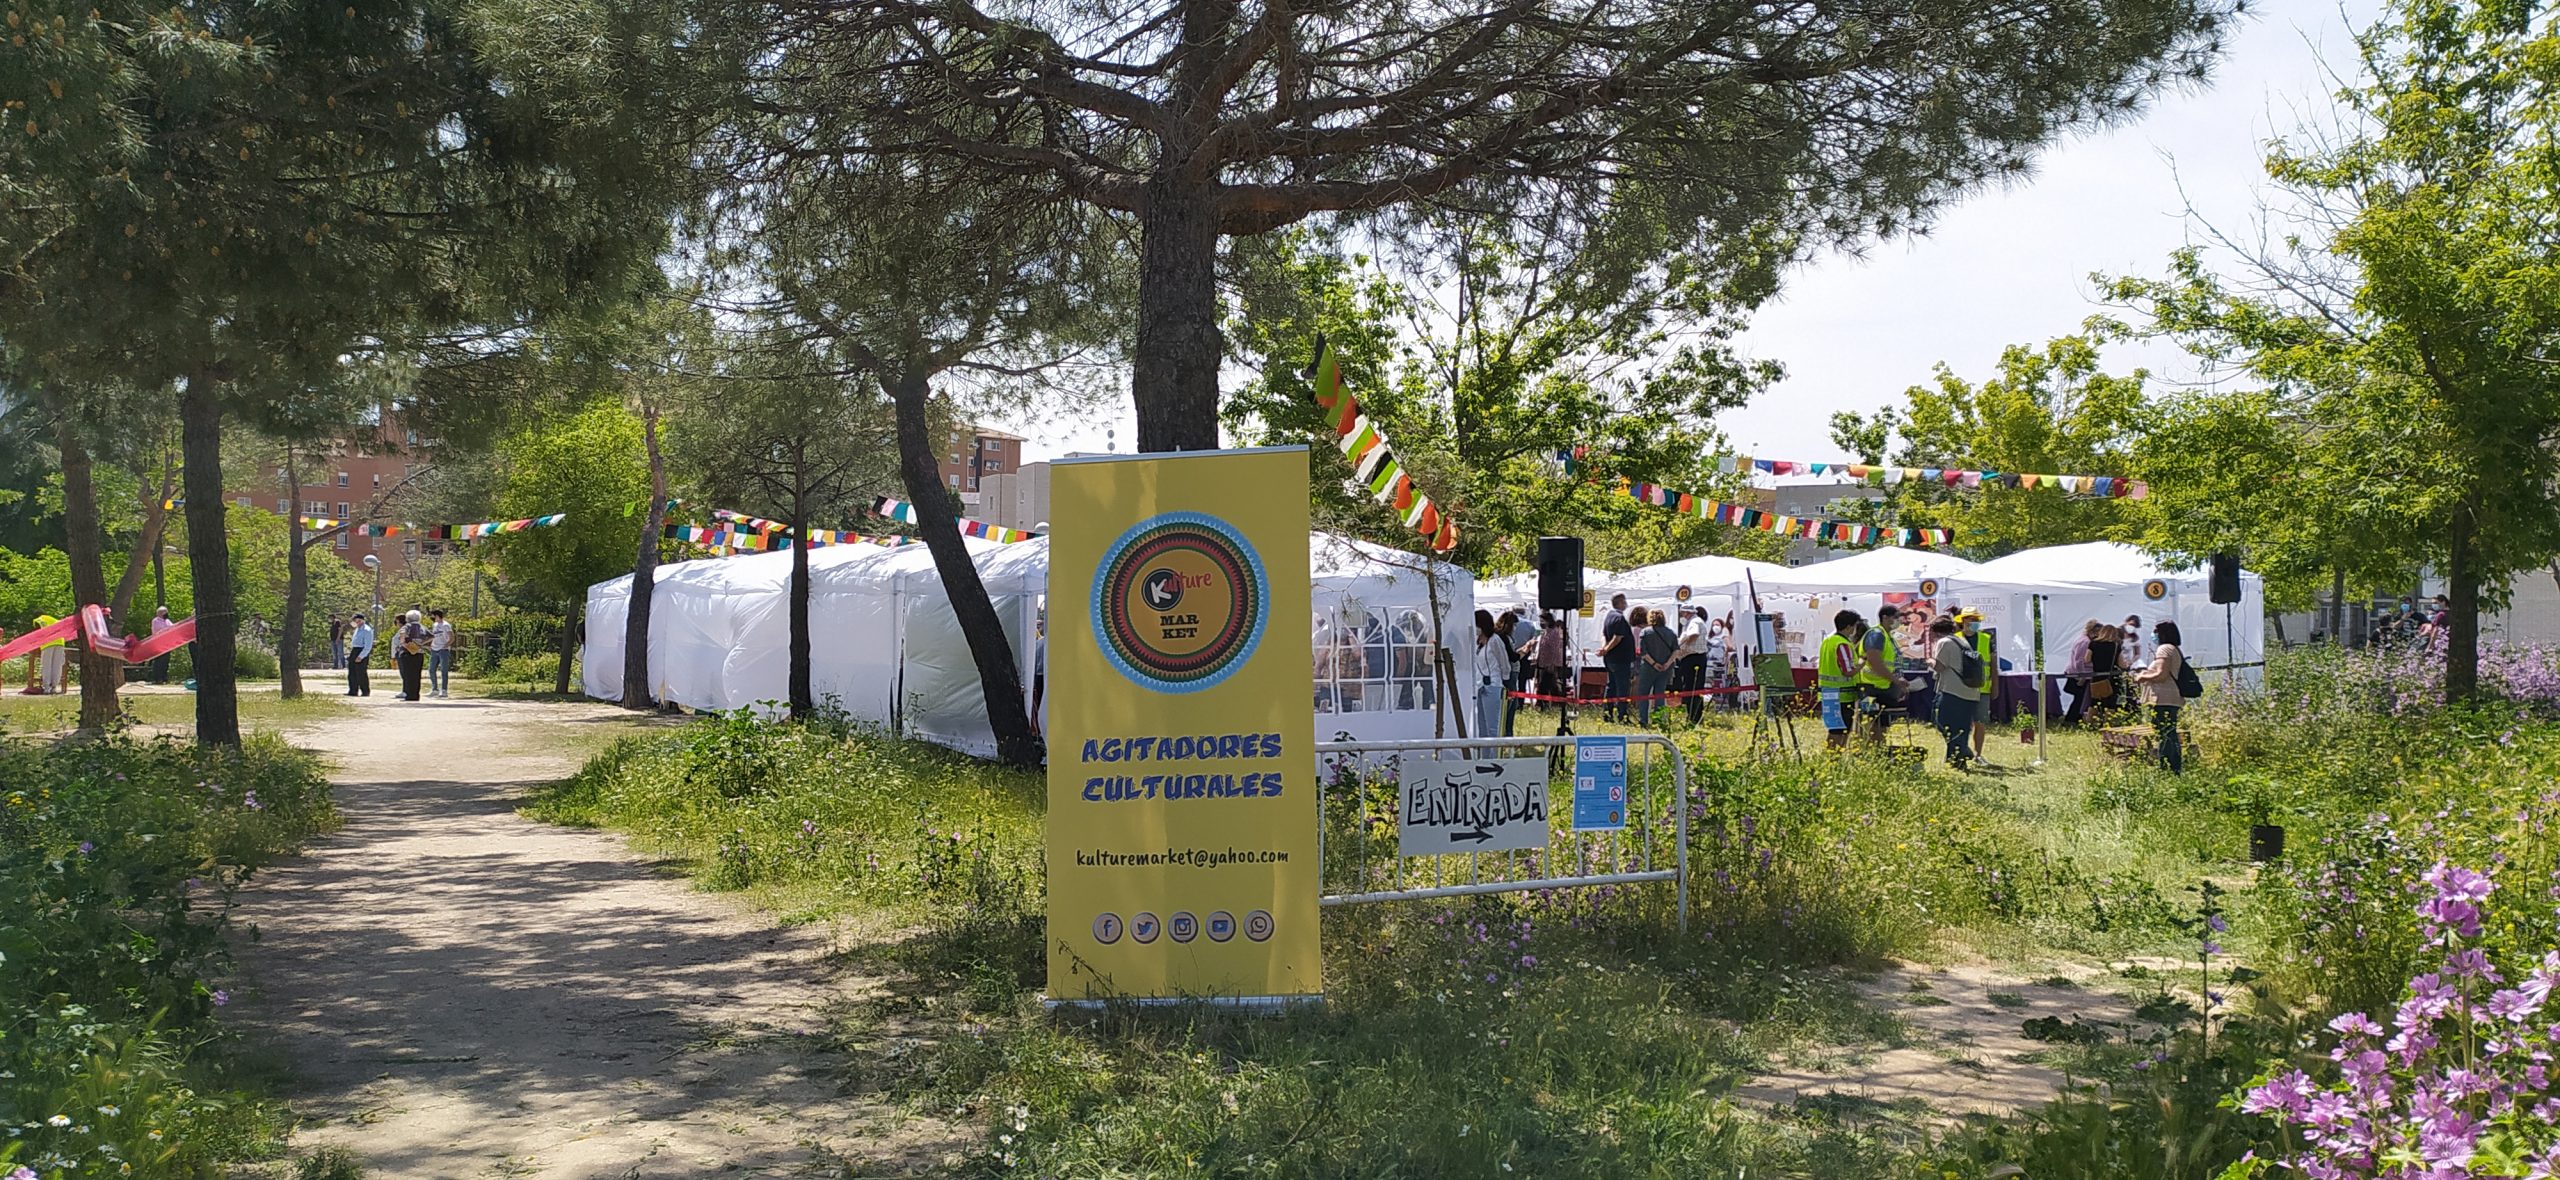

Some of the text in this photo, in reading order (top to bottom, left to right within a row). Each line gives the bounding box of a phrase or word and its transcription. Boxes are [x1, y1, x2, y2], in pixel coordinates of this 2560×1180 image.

[1150, 571, 1212, 604] Kulture
[1926, 583, 1933, 593] 9
[1971, 597, 2001, 605] MUERTE
[1159, 614, 1200, 627] MAR
[1162, 627, 1198, 640] KET
[1081, 733, 1283, 763] AGITADORES
[1081, 772, 1284, 802] CULTURALES
[1407, 771, 1548, 829] ENTRADA
[1076, 847, 1289, 868] kulturemarket@yahoo.com
